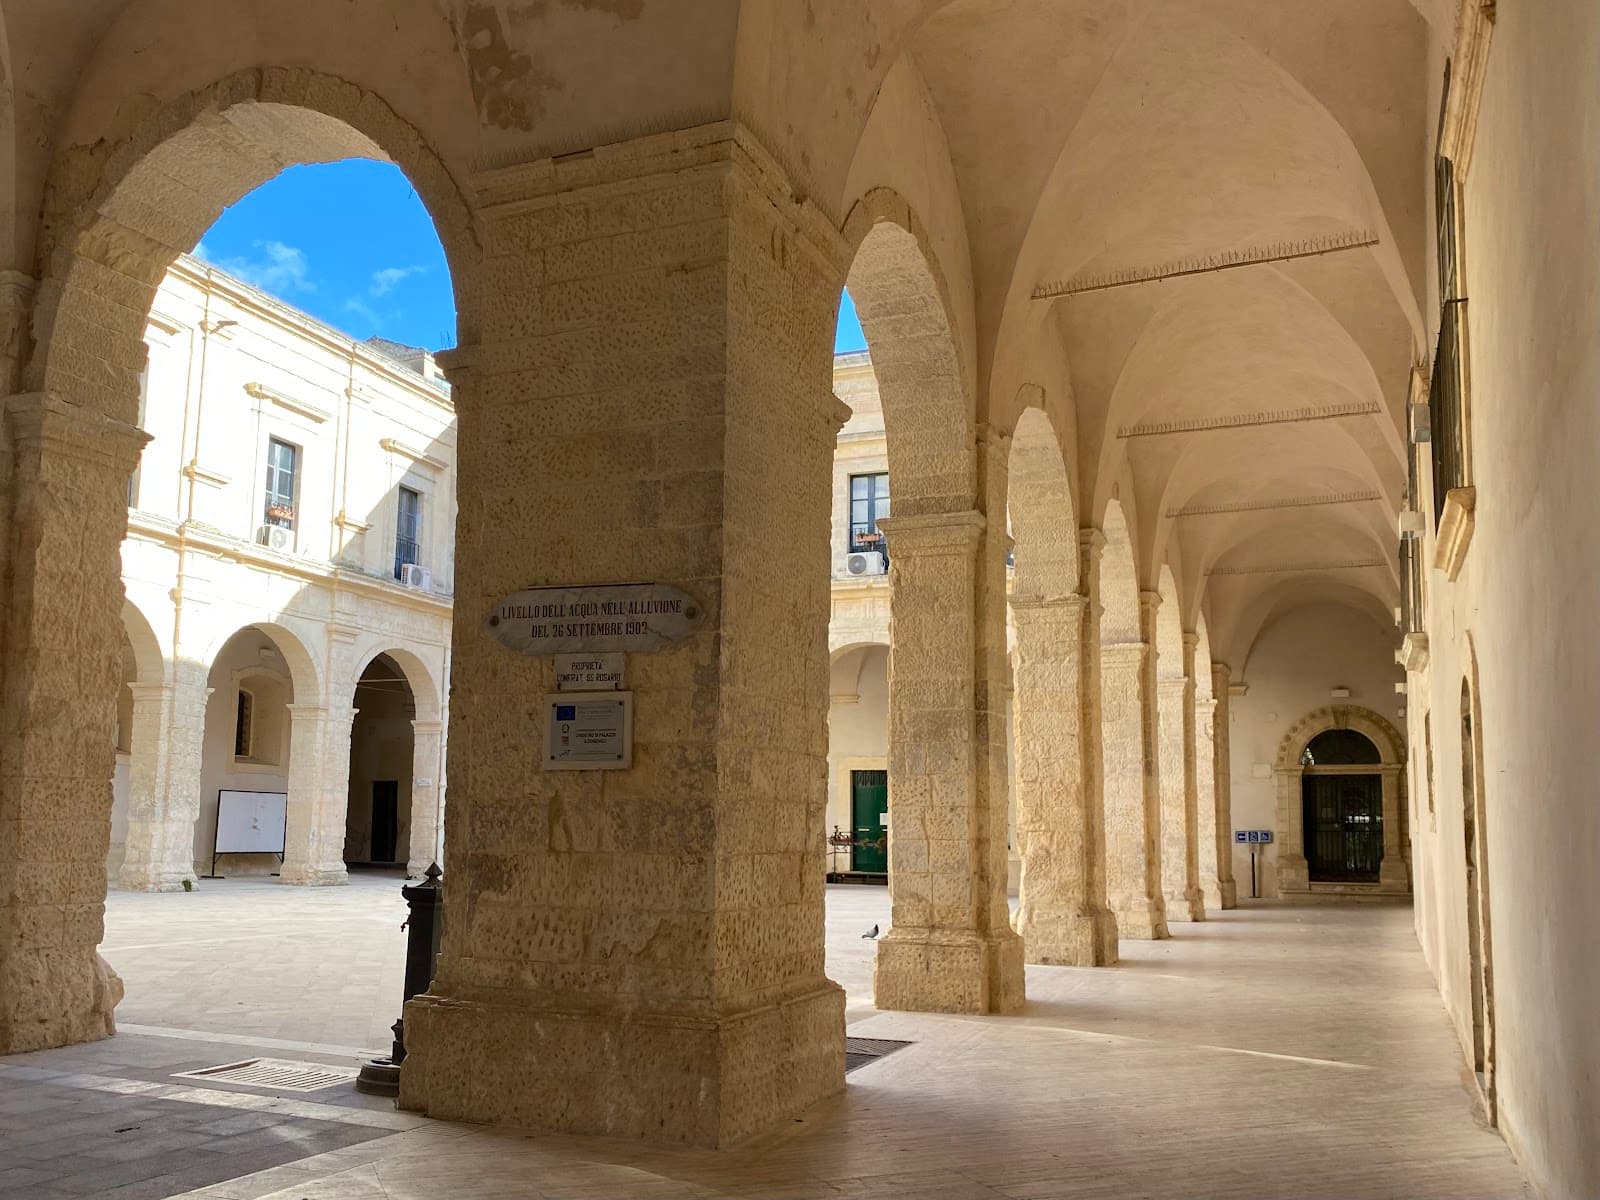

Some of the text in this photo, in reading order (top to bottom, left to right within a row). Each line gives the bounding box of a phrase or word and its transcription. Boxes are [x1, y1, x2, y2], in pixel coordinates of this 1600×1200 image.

[502, 605, 540, 620] LIVELLO
[531, 621, 648, 638] DEL 26 SETTEMBRE 1902
